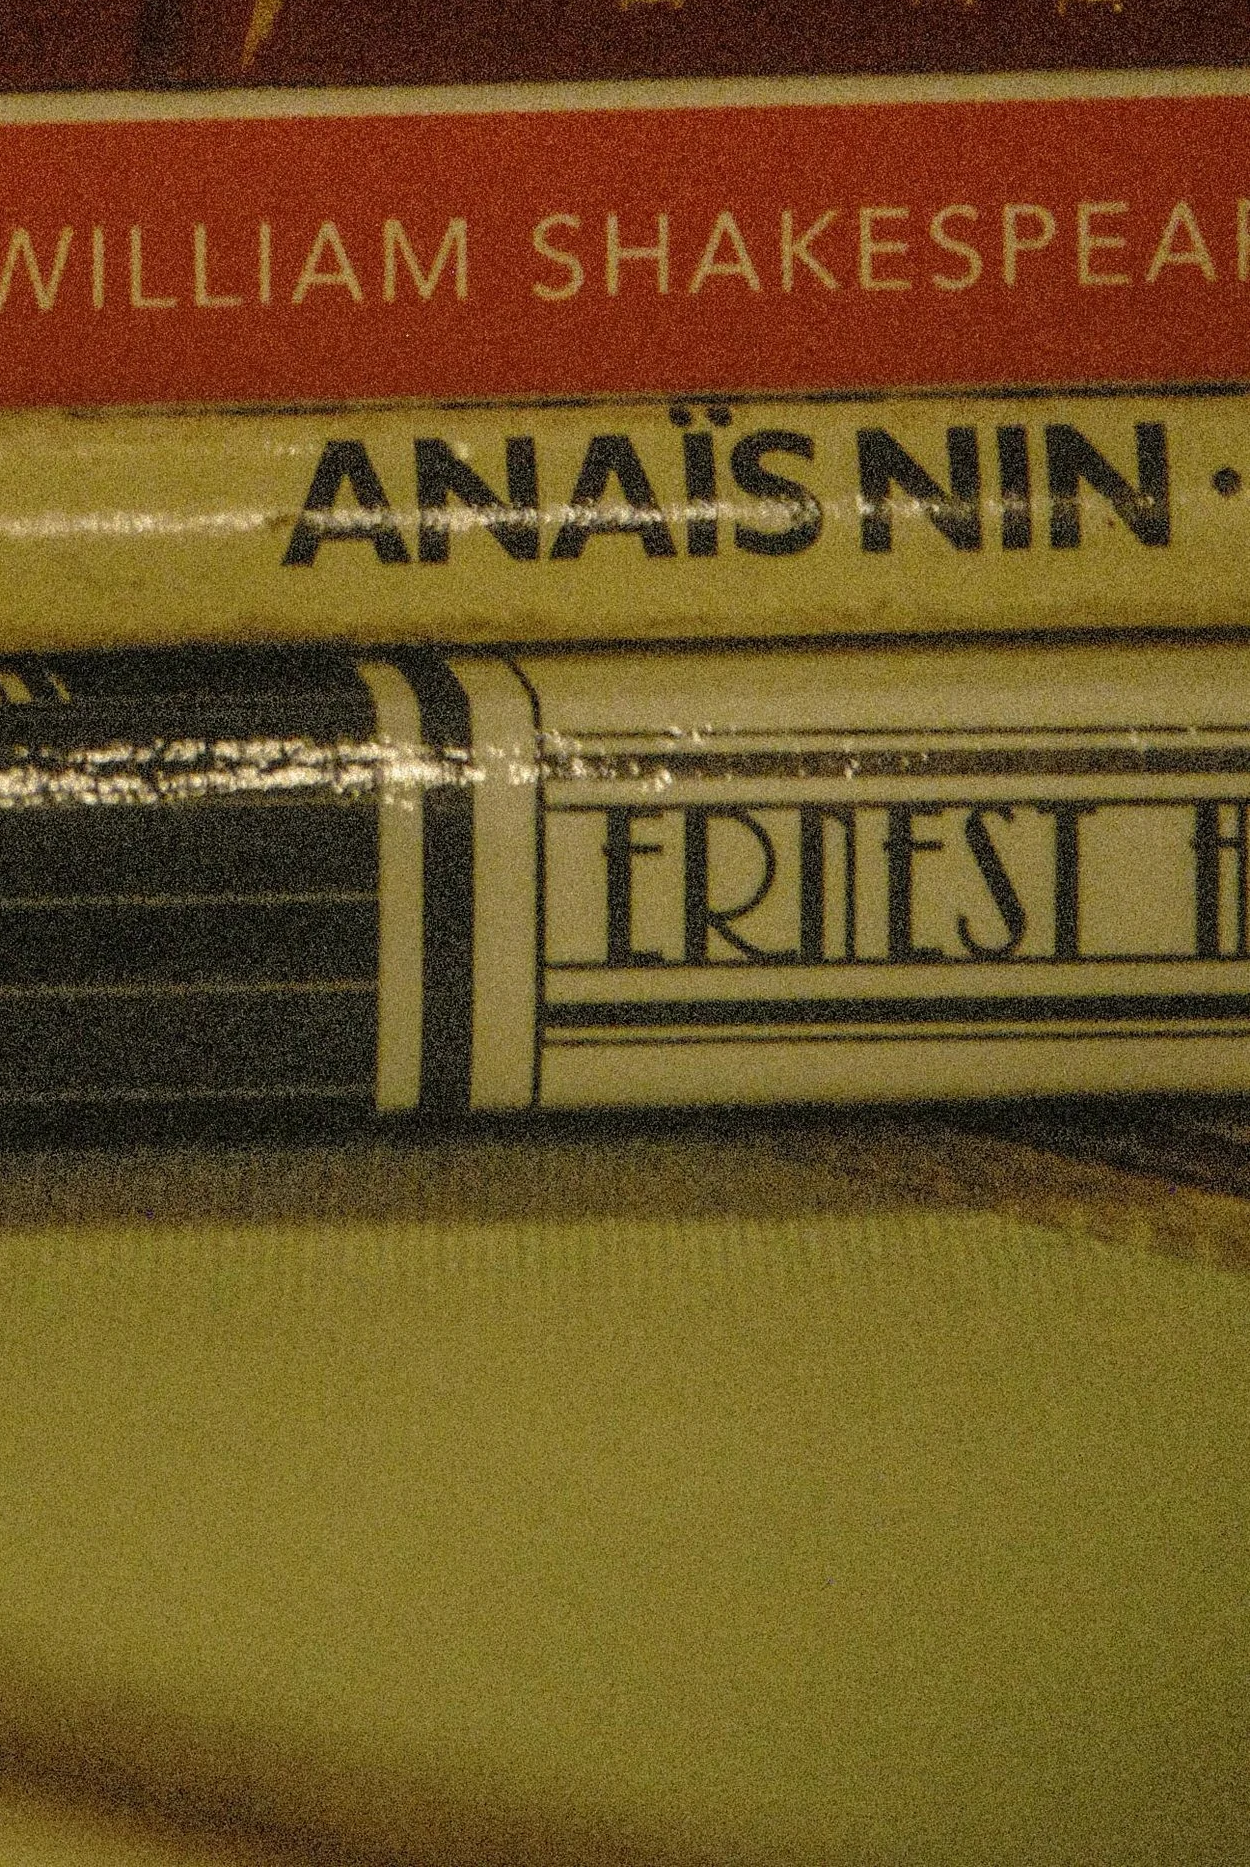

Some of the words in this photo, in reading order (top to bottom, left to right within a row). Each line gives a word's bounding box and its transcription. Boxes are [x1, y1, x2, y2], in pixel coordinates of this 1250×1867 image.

[281, 406, 826, 568] ANAÏS
[856, 422, 1171, 553] NIN
[602, 802, 1097, 967] ERNEST
